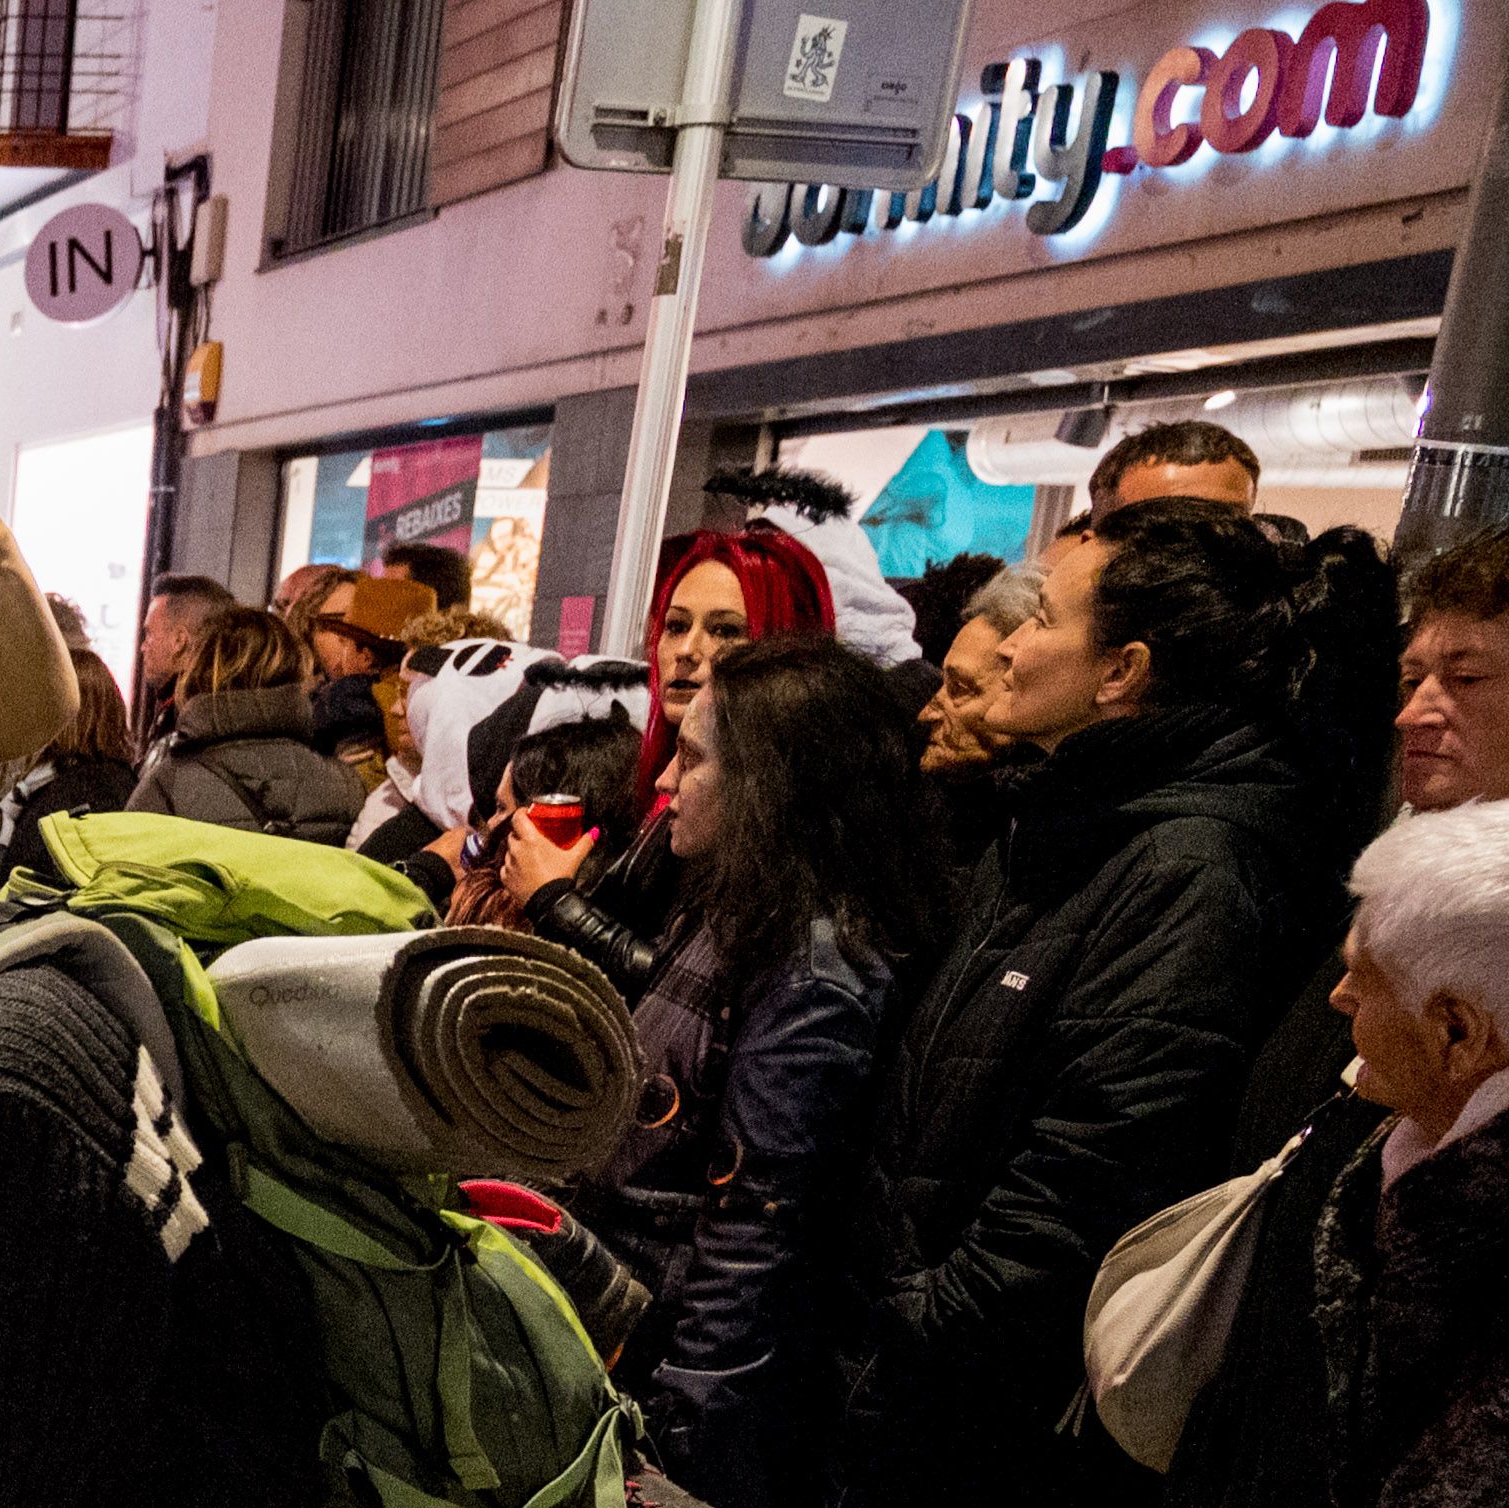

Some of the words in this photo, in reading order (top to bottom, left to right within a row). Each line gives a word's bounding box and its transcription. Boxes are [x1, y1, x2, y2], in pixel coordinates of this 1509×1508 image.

[49, 229, 113, 298] IN
[395, 490, 463, 541] REBAIXES
[1001, 970, 1029, 991] VANS
